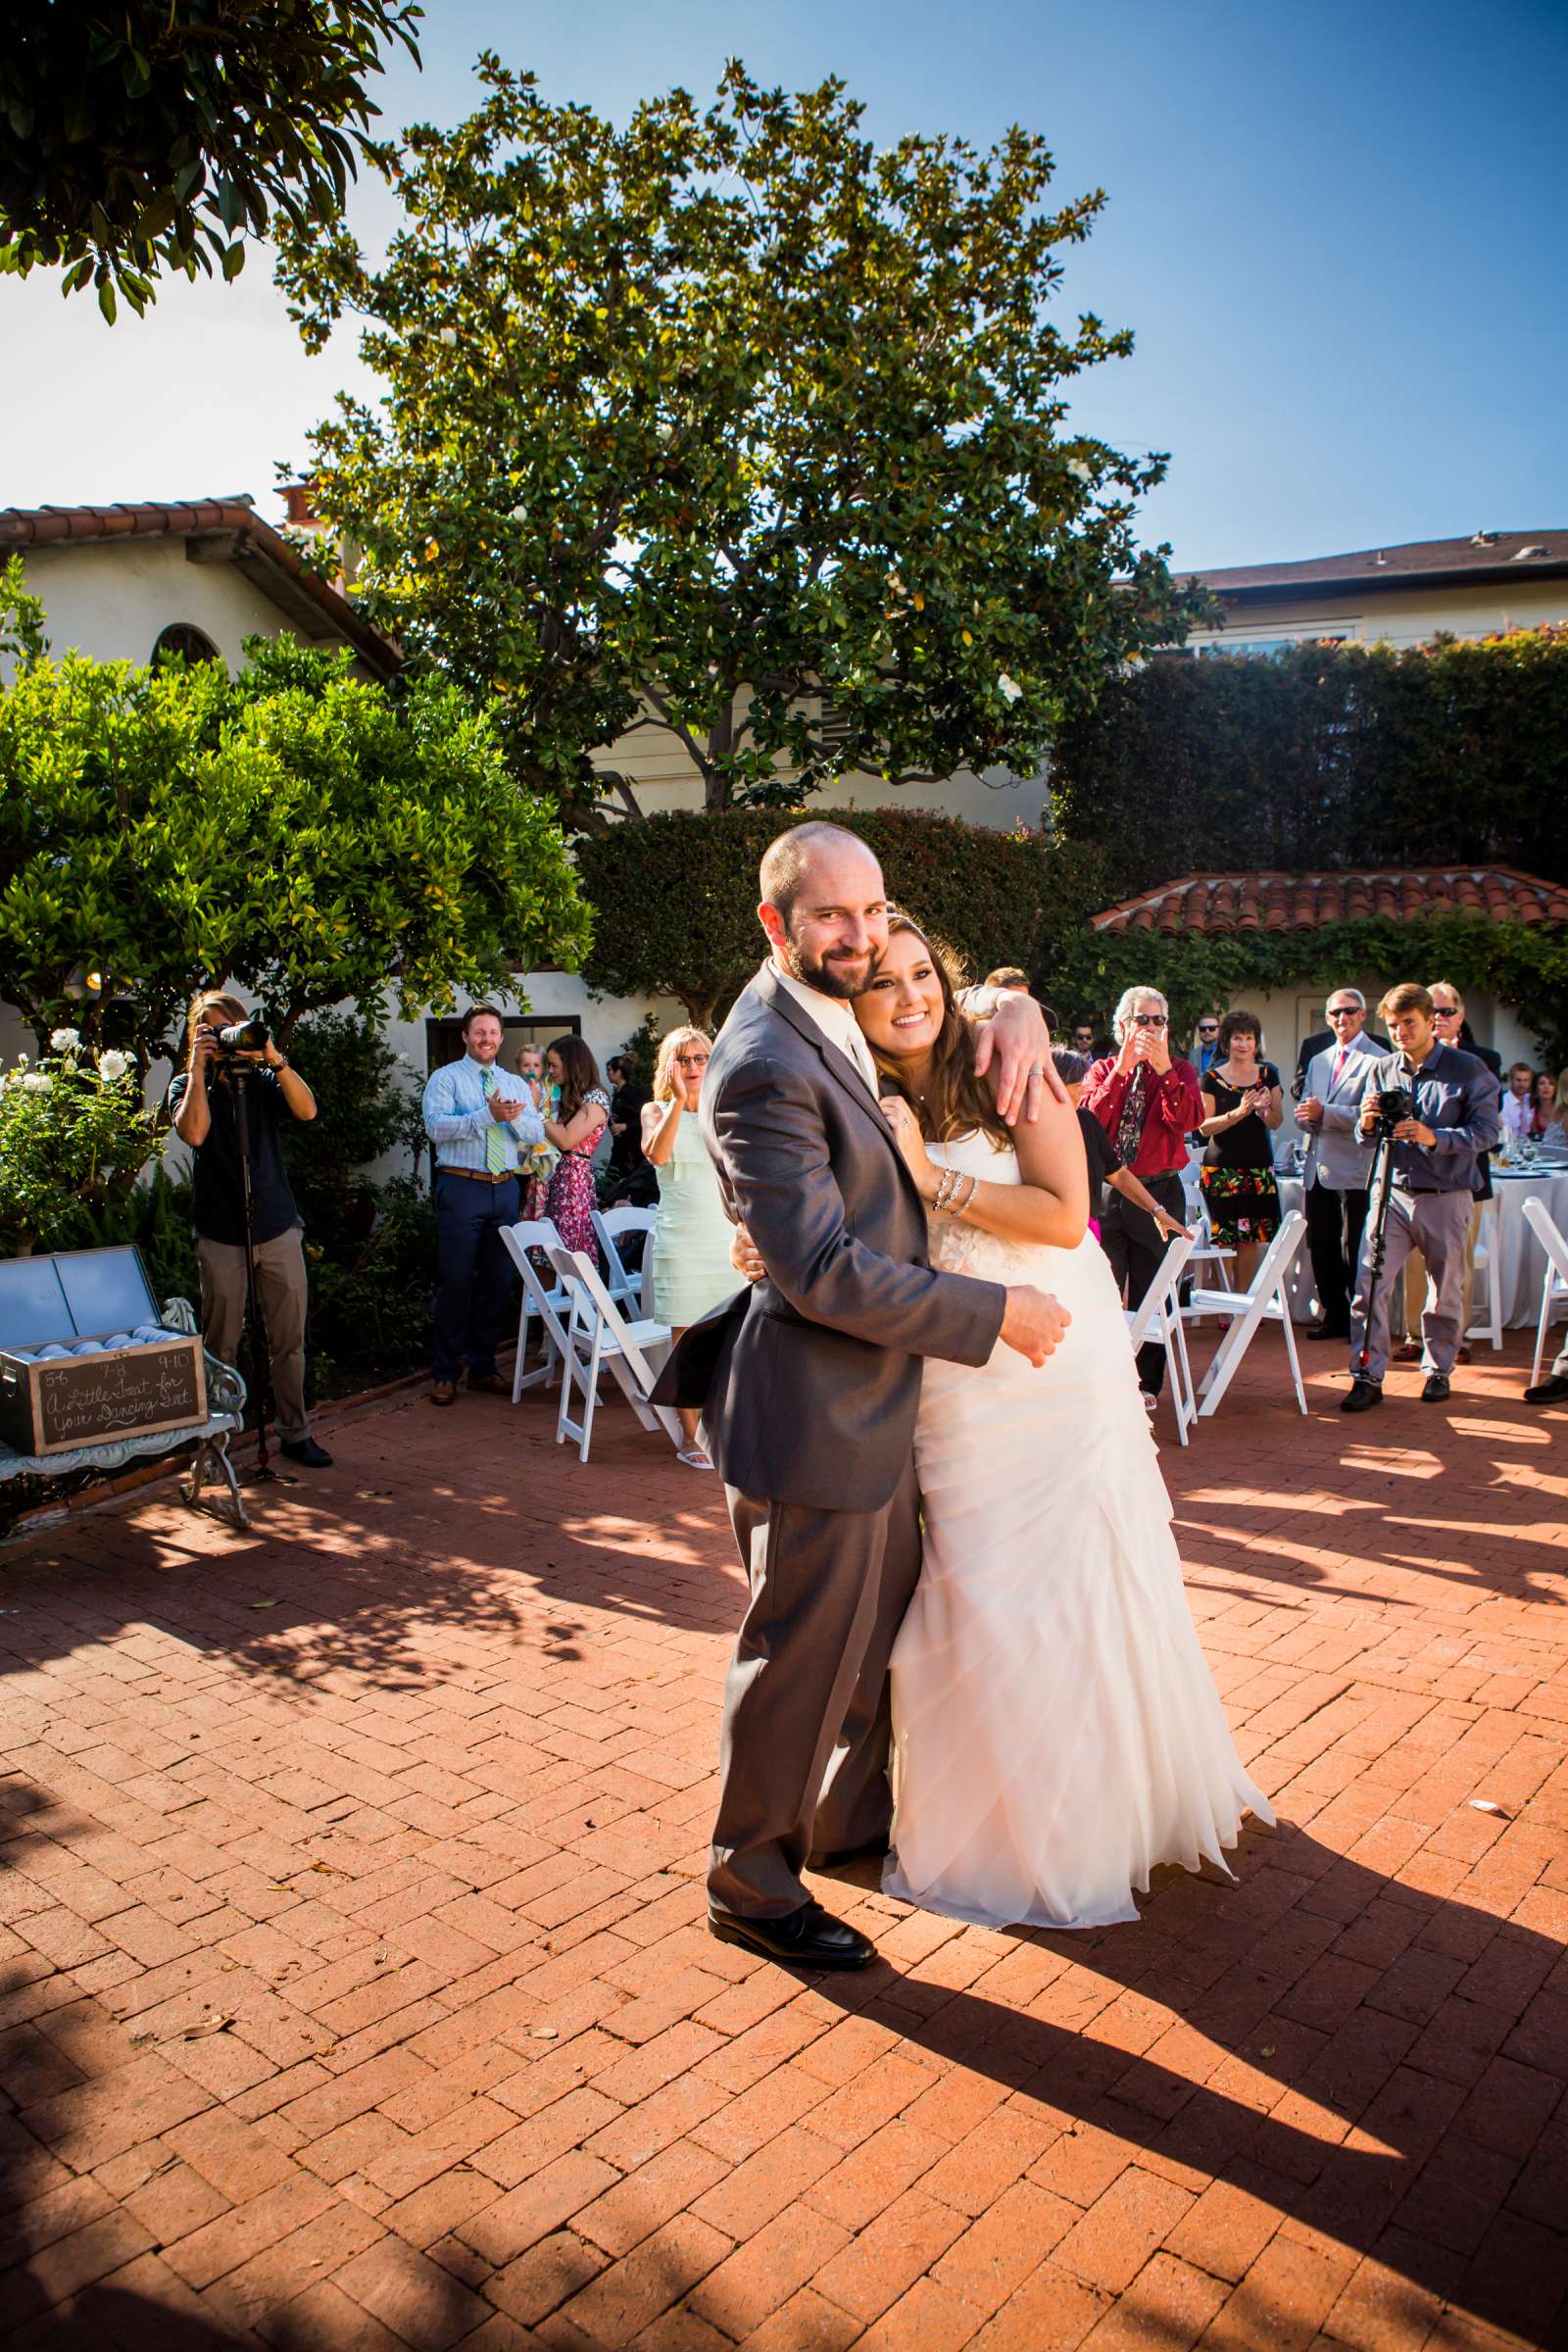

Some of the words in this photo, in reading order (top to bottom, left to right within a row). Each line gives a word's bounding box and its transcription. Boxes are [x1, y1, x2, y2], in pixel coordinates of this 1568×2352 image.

[159, 1354, 189, 1369] 9-10
[67, 1386, 111, 1410] Little
[156, 1372, 183, 1396] for
[98, 1399, 158, 1419] Dancing
